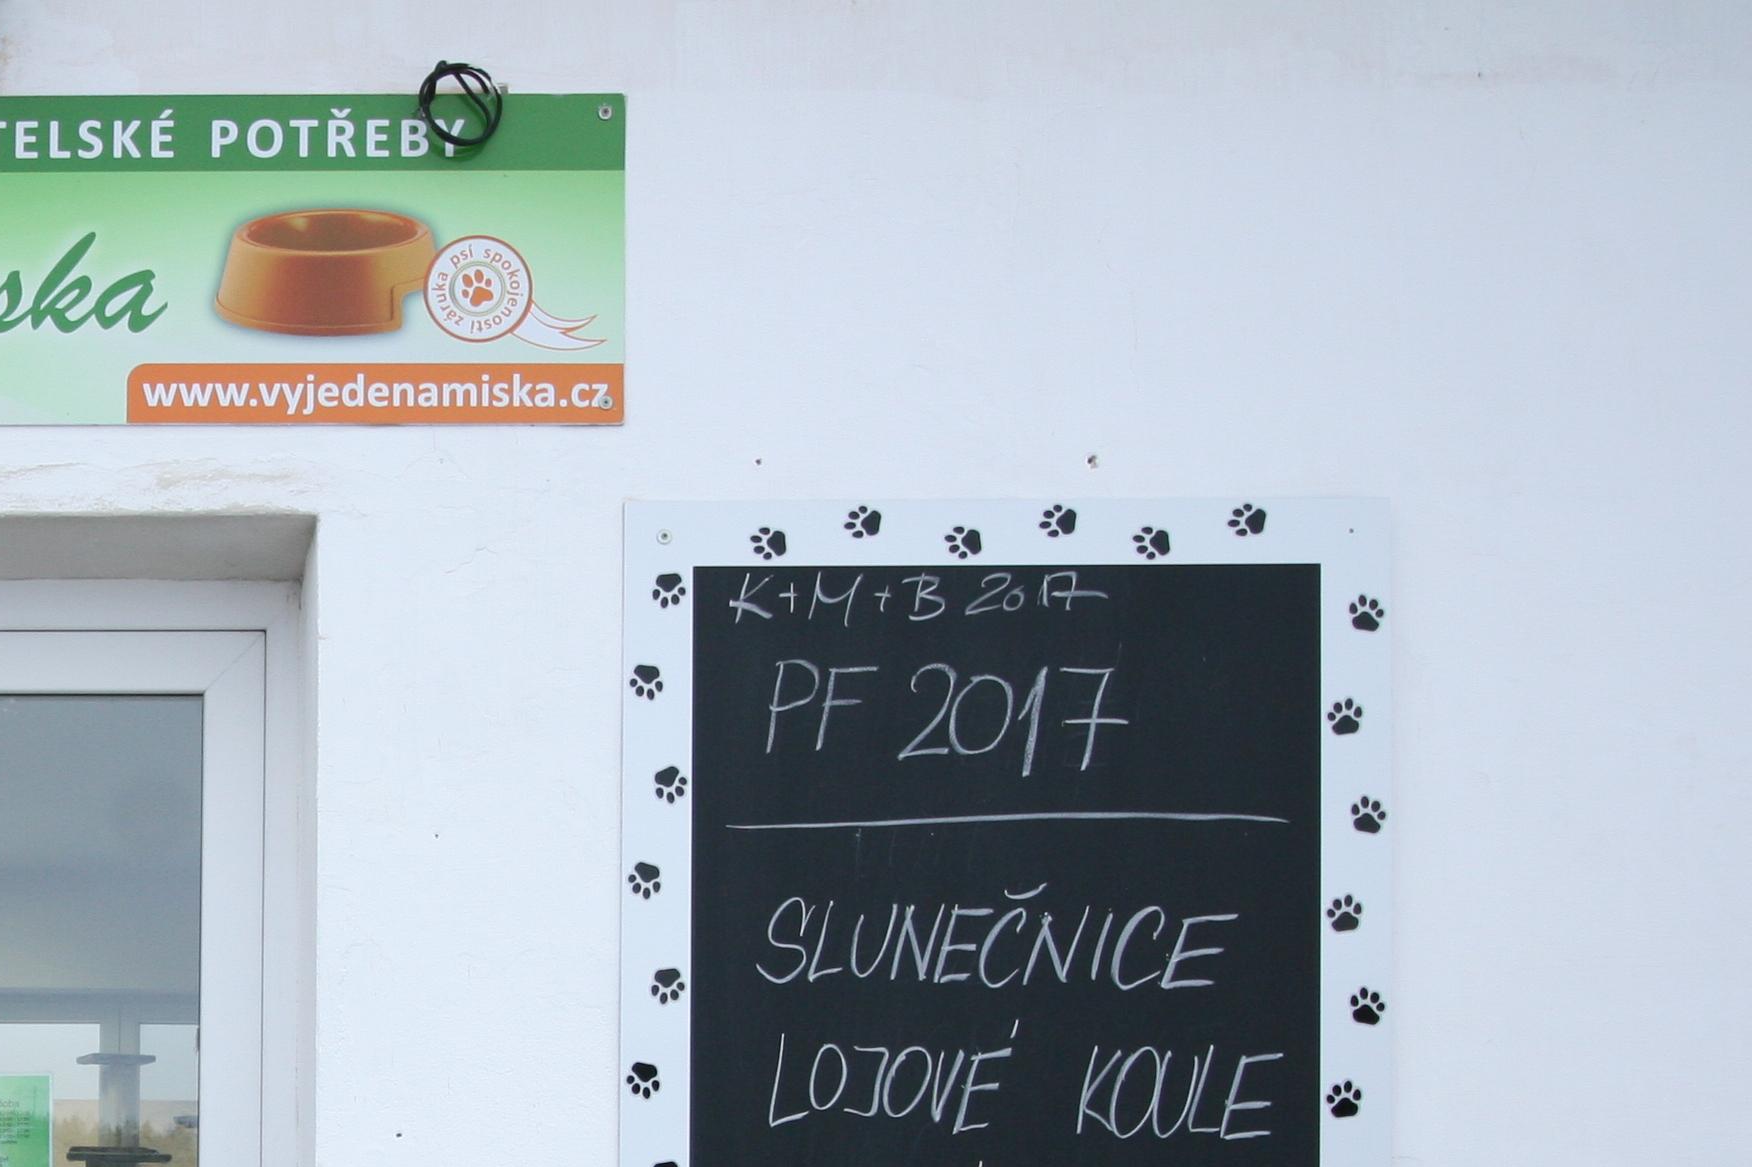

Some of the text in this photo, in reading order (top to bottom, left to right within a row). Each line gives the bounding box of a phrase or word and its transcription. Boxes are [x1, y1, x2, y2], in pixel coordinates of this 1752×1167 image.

[210, 106, 466, 159] POTŘEBY
[431, 243, 524, 334] záruka psí spokojenosti
[142, 373, 609, 415] www.vyjedenamiska.cz
[964, 571, 1108, 616] 2017
[766, 659, 1129, 777] PF 2017
[756, 882, 1239, 990] SLUNEČNICE
[768, 1018, 1284, 1139] LOJOVÉ KOULE
